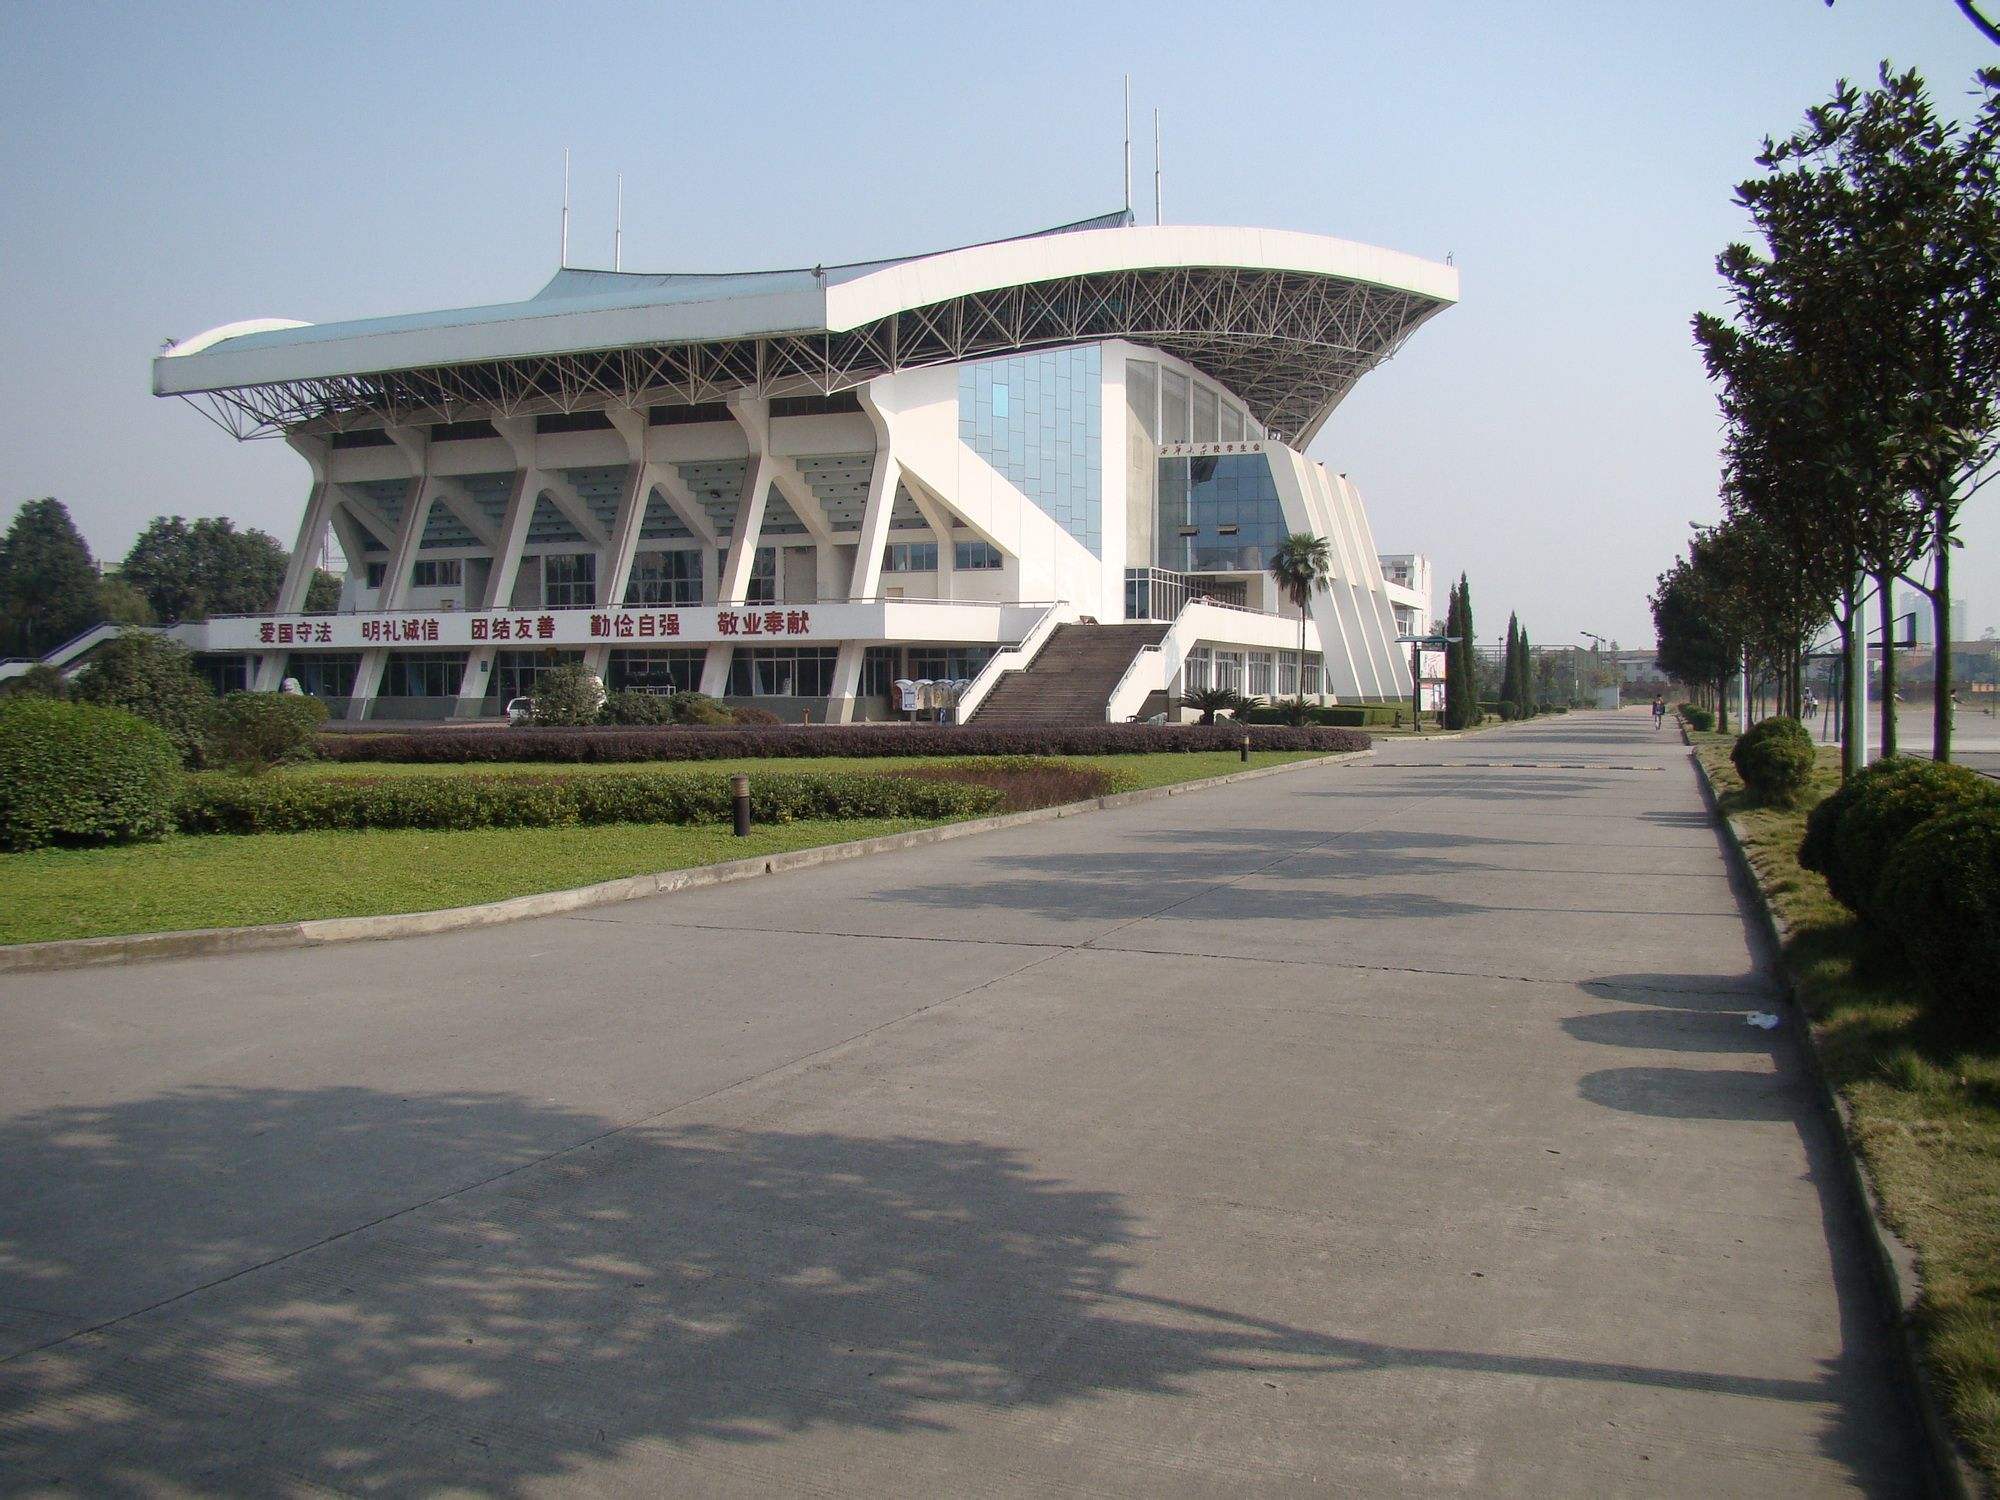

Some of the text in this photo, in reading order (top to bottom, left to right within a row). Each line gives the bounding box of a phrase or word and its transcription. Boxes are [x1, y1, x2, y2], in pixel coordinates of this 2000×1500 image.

[259, 610, 810, 644] 爱国守法 明礼诚信 团结友善 勤俭自强 敬业奉献
